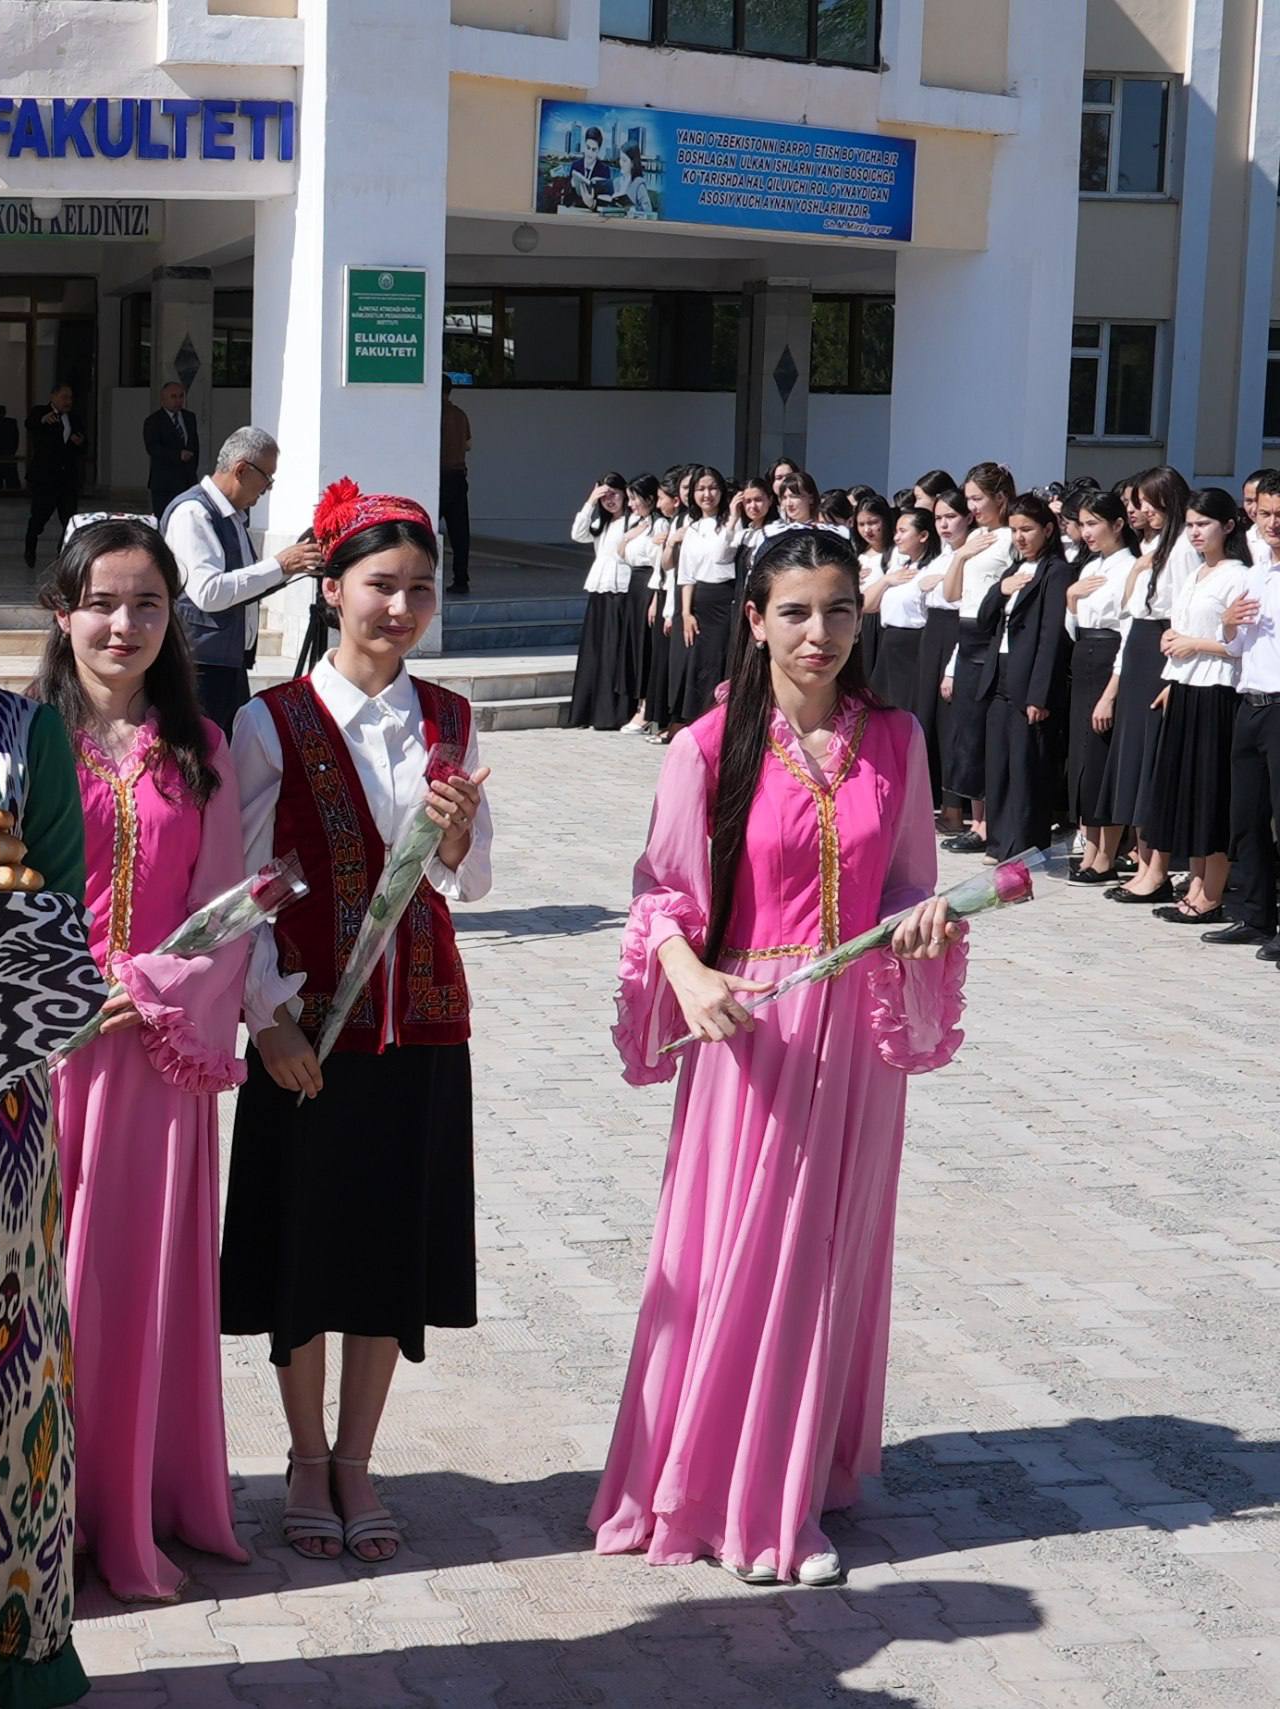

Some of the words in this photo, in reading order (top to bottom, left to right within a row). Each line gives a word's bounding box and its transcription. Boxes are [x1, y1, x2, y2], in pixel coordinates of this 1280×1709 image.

[677, 129, 705, 145] YANGI
[780, 141, 811, 157] BARPO
[814, 144, 840, 160] ETISH
[882, 151, 898, 166] BIZ
[678, 149, 736, 168] BOSHLAGAN
[740, 155, 770, 171] ULKAN
[773, 158, 814, 176] ISHLARNI
[816, 163, 842, 179] YANGI
[844, 167, 895, 184] BOSQICHGA
[745, 175, 764, 190] HAL
[766, 178, 807, 195] QILUVCHI
[810, 181, 828, 196] ROL
[699, 190, 734, 206] ASOSIY
[735, 194, 760, 209] KUCH
[761, 196, 793, 212] AYNAN
[354, 332, 417, 344] ELLIKQALA
[355, 346, 416, 357] FAKULTETI
